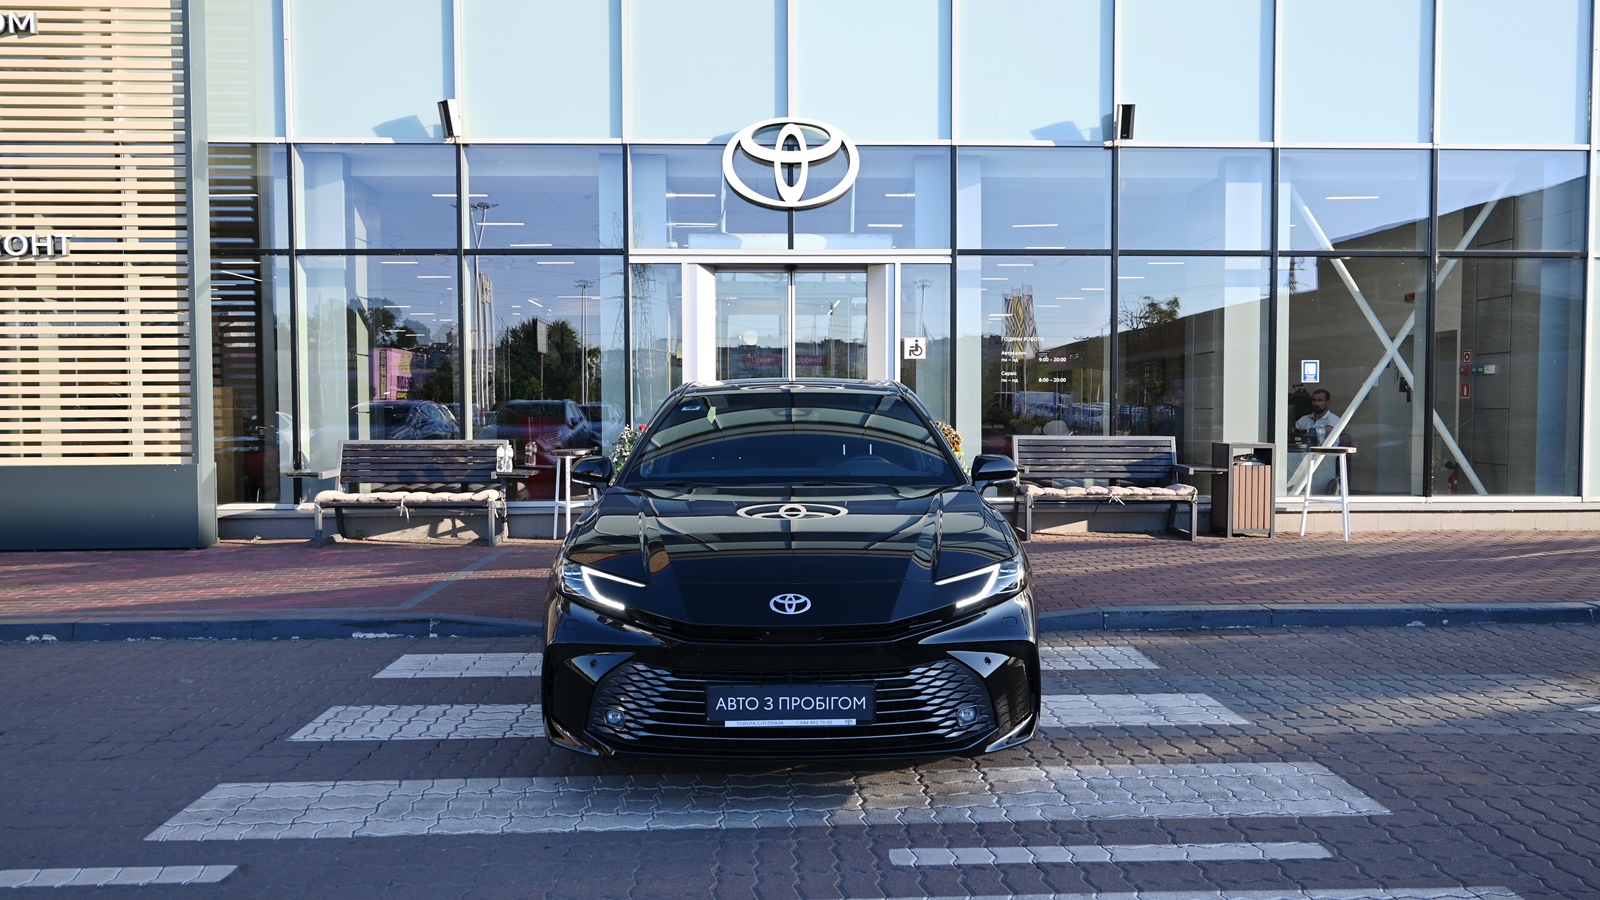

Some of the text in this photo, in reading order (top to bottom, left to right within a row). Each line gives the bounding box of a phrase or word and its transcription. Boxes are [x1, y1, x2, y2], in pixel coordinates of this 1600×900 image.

[0, 10, 38, 35] М
[0, 233, 76, 257] ОНТ
[715, 696, 866, 711] АВТО З ПРОБІГОМ
